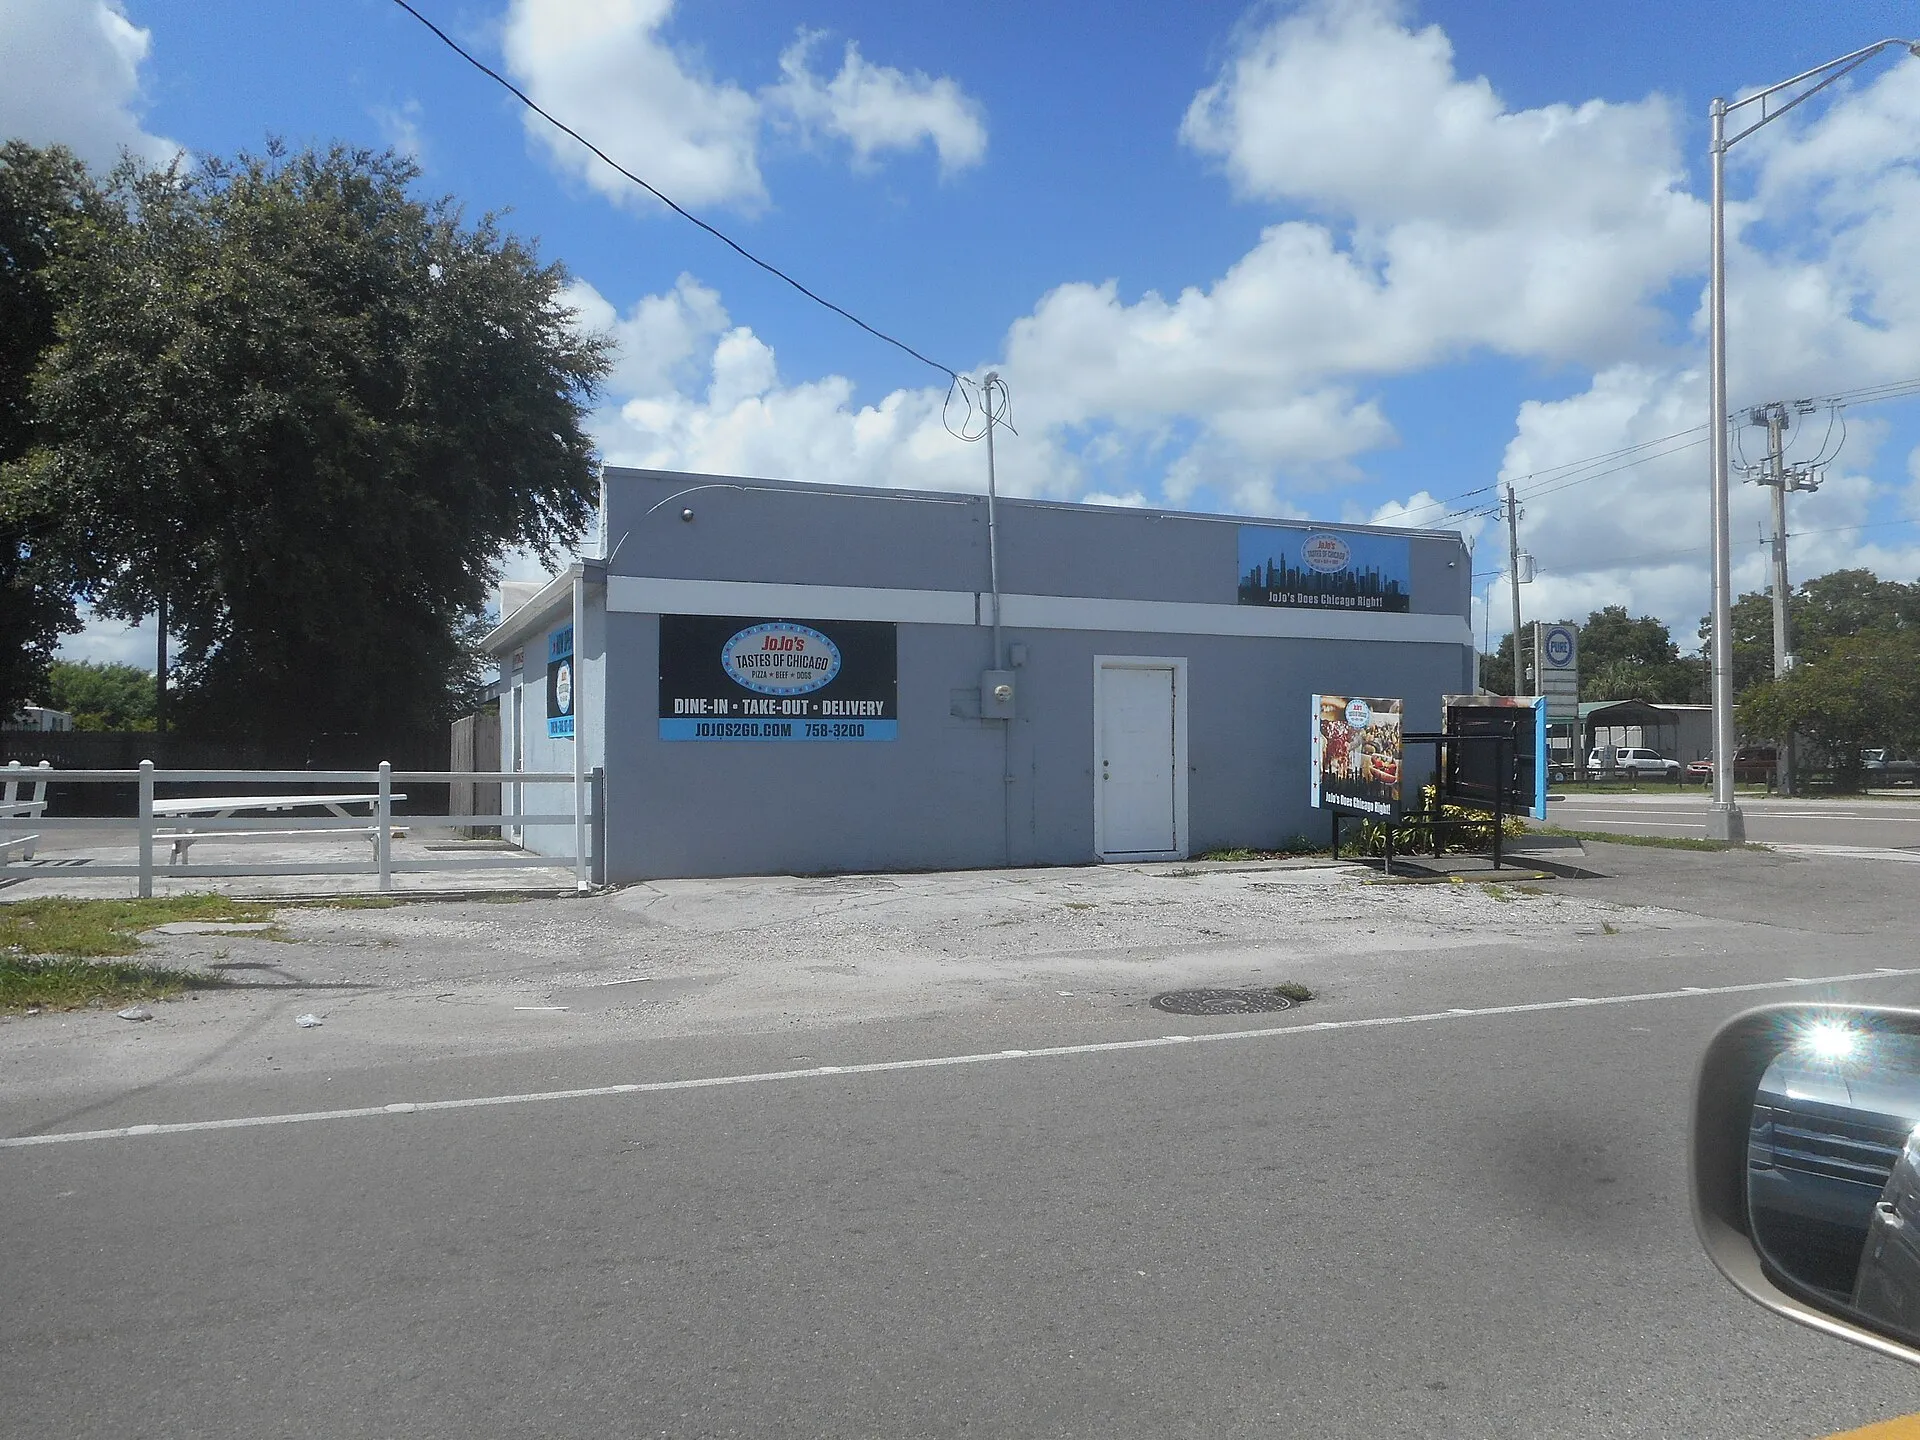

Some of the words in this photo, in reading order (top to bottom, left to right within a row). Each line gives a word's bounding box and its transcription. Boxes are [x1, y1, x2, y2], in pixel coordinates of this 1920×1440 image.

[1317, 540, 1336, 550] JoJo's
[1268, 591, 1295, 603] JoJo's
[1297, 593, 1319, 604] Does
[1321, 593, 1356, 607] Chicago
[1357, 595, 1383, 608] Right!
[761, 635, 805, 652] JoJo's
[1550, 641, 1569, 654] PURE
[736, 653, 771, 669] TASTES
[773, 653, 785, 667] OF
[786, 654, 829, 671] CHICAGO
[751, 670, 767, 679] PIZZA
[775, 671, 788, 679] BEEF
[796, 671, 812, 680] DOGS
[674, 698, 729, 715] DINE-IN
[742, 699, 809, 716] TAKE-OUT
[822, 700, 884, 716] DELIVERY
[695, 723, 792, 737] JOJOS2GO.COM
[805, 723, 865, 737] 758-3200
[1353, 796, 1374, 812] Chicago
[1374, 801, 1391, 815] Right!
